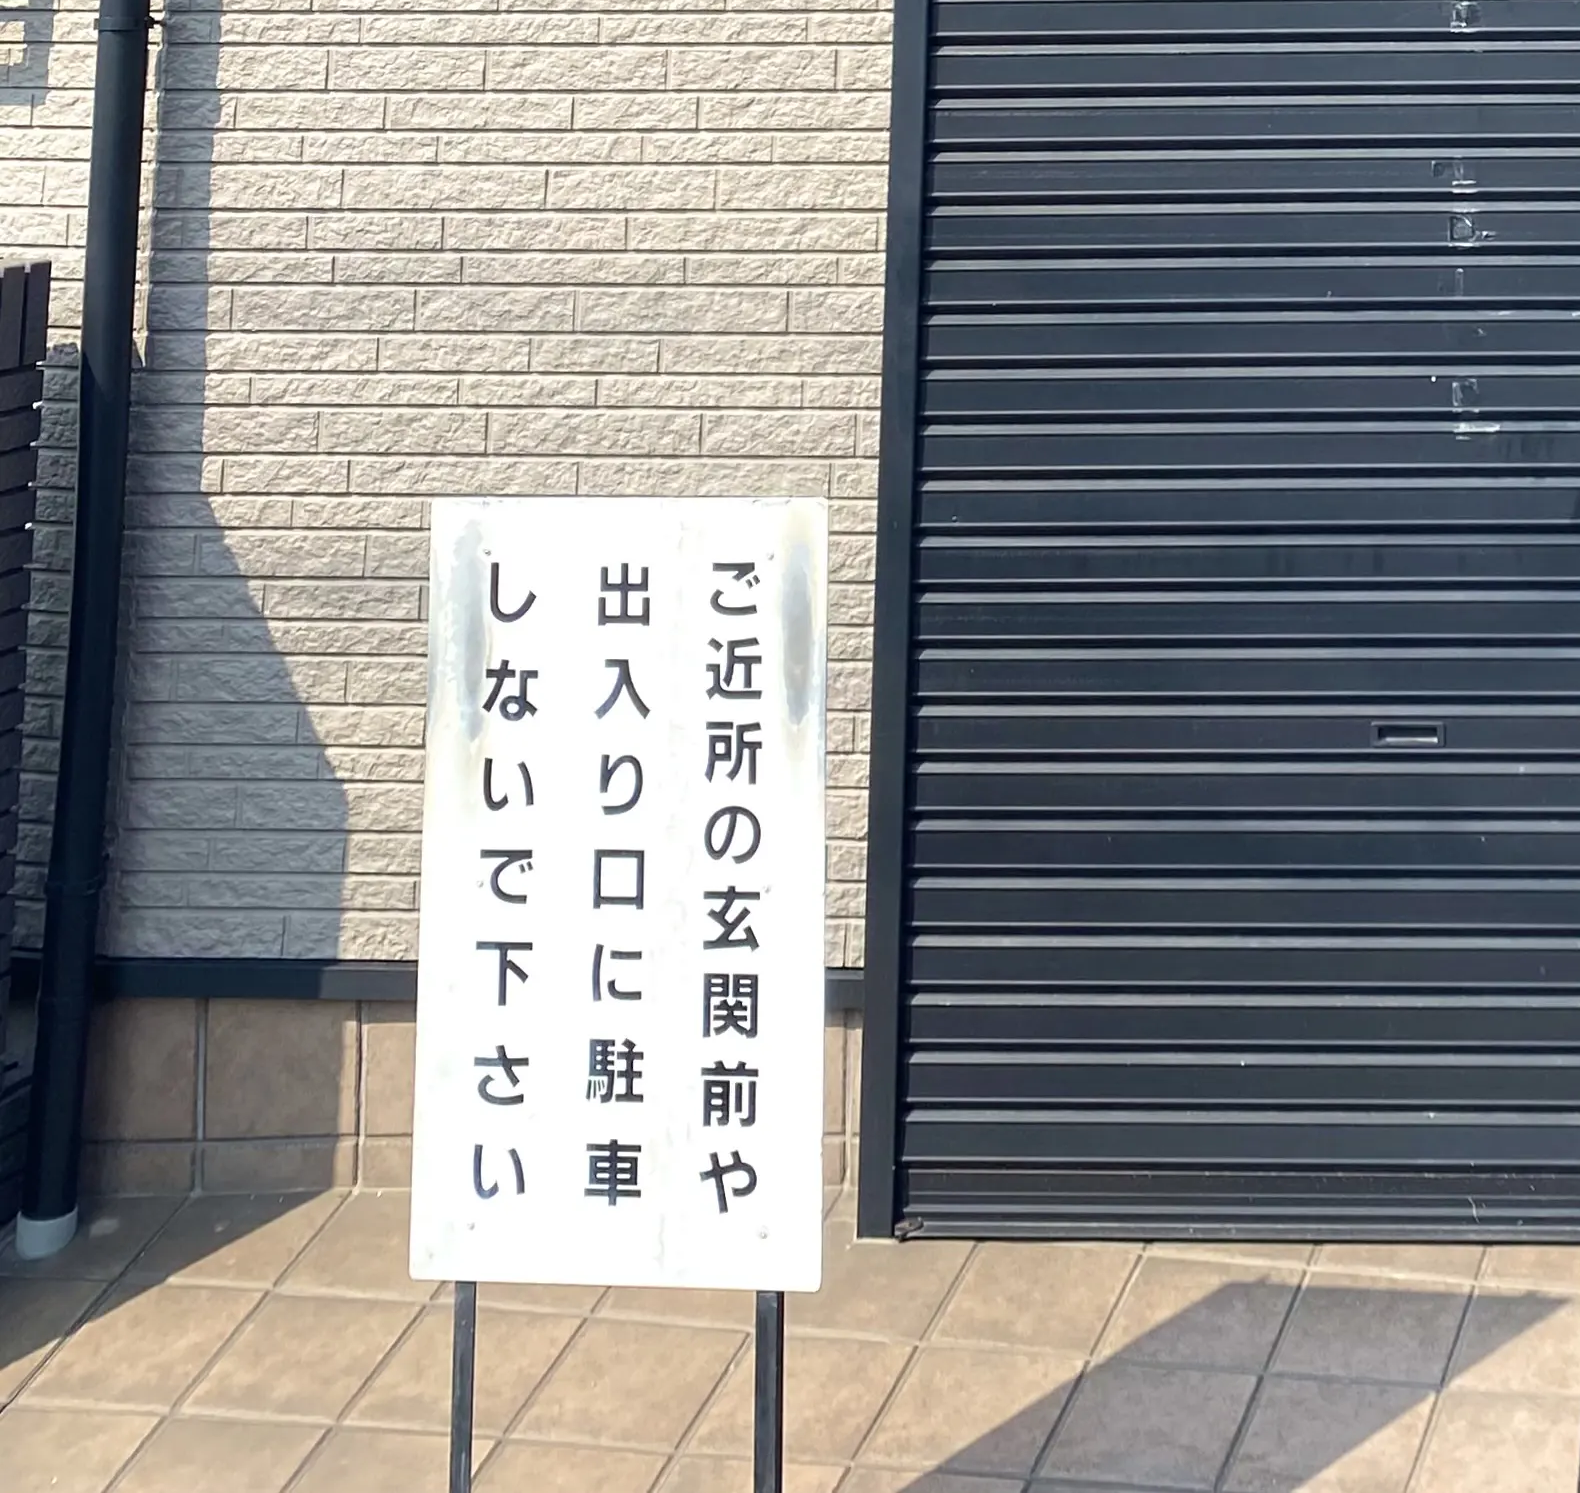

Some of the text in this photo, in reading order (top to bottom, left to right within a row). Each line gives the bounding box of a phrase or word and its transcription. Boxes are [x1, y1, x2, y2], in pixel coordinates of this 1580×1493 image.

[471, 560, 539, 1201] しないで下さい
[584, 561, 652, 1208] 出入り口に駐車
[700, 560, 763, 1216] ご近所の玄関前や
